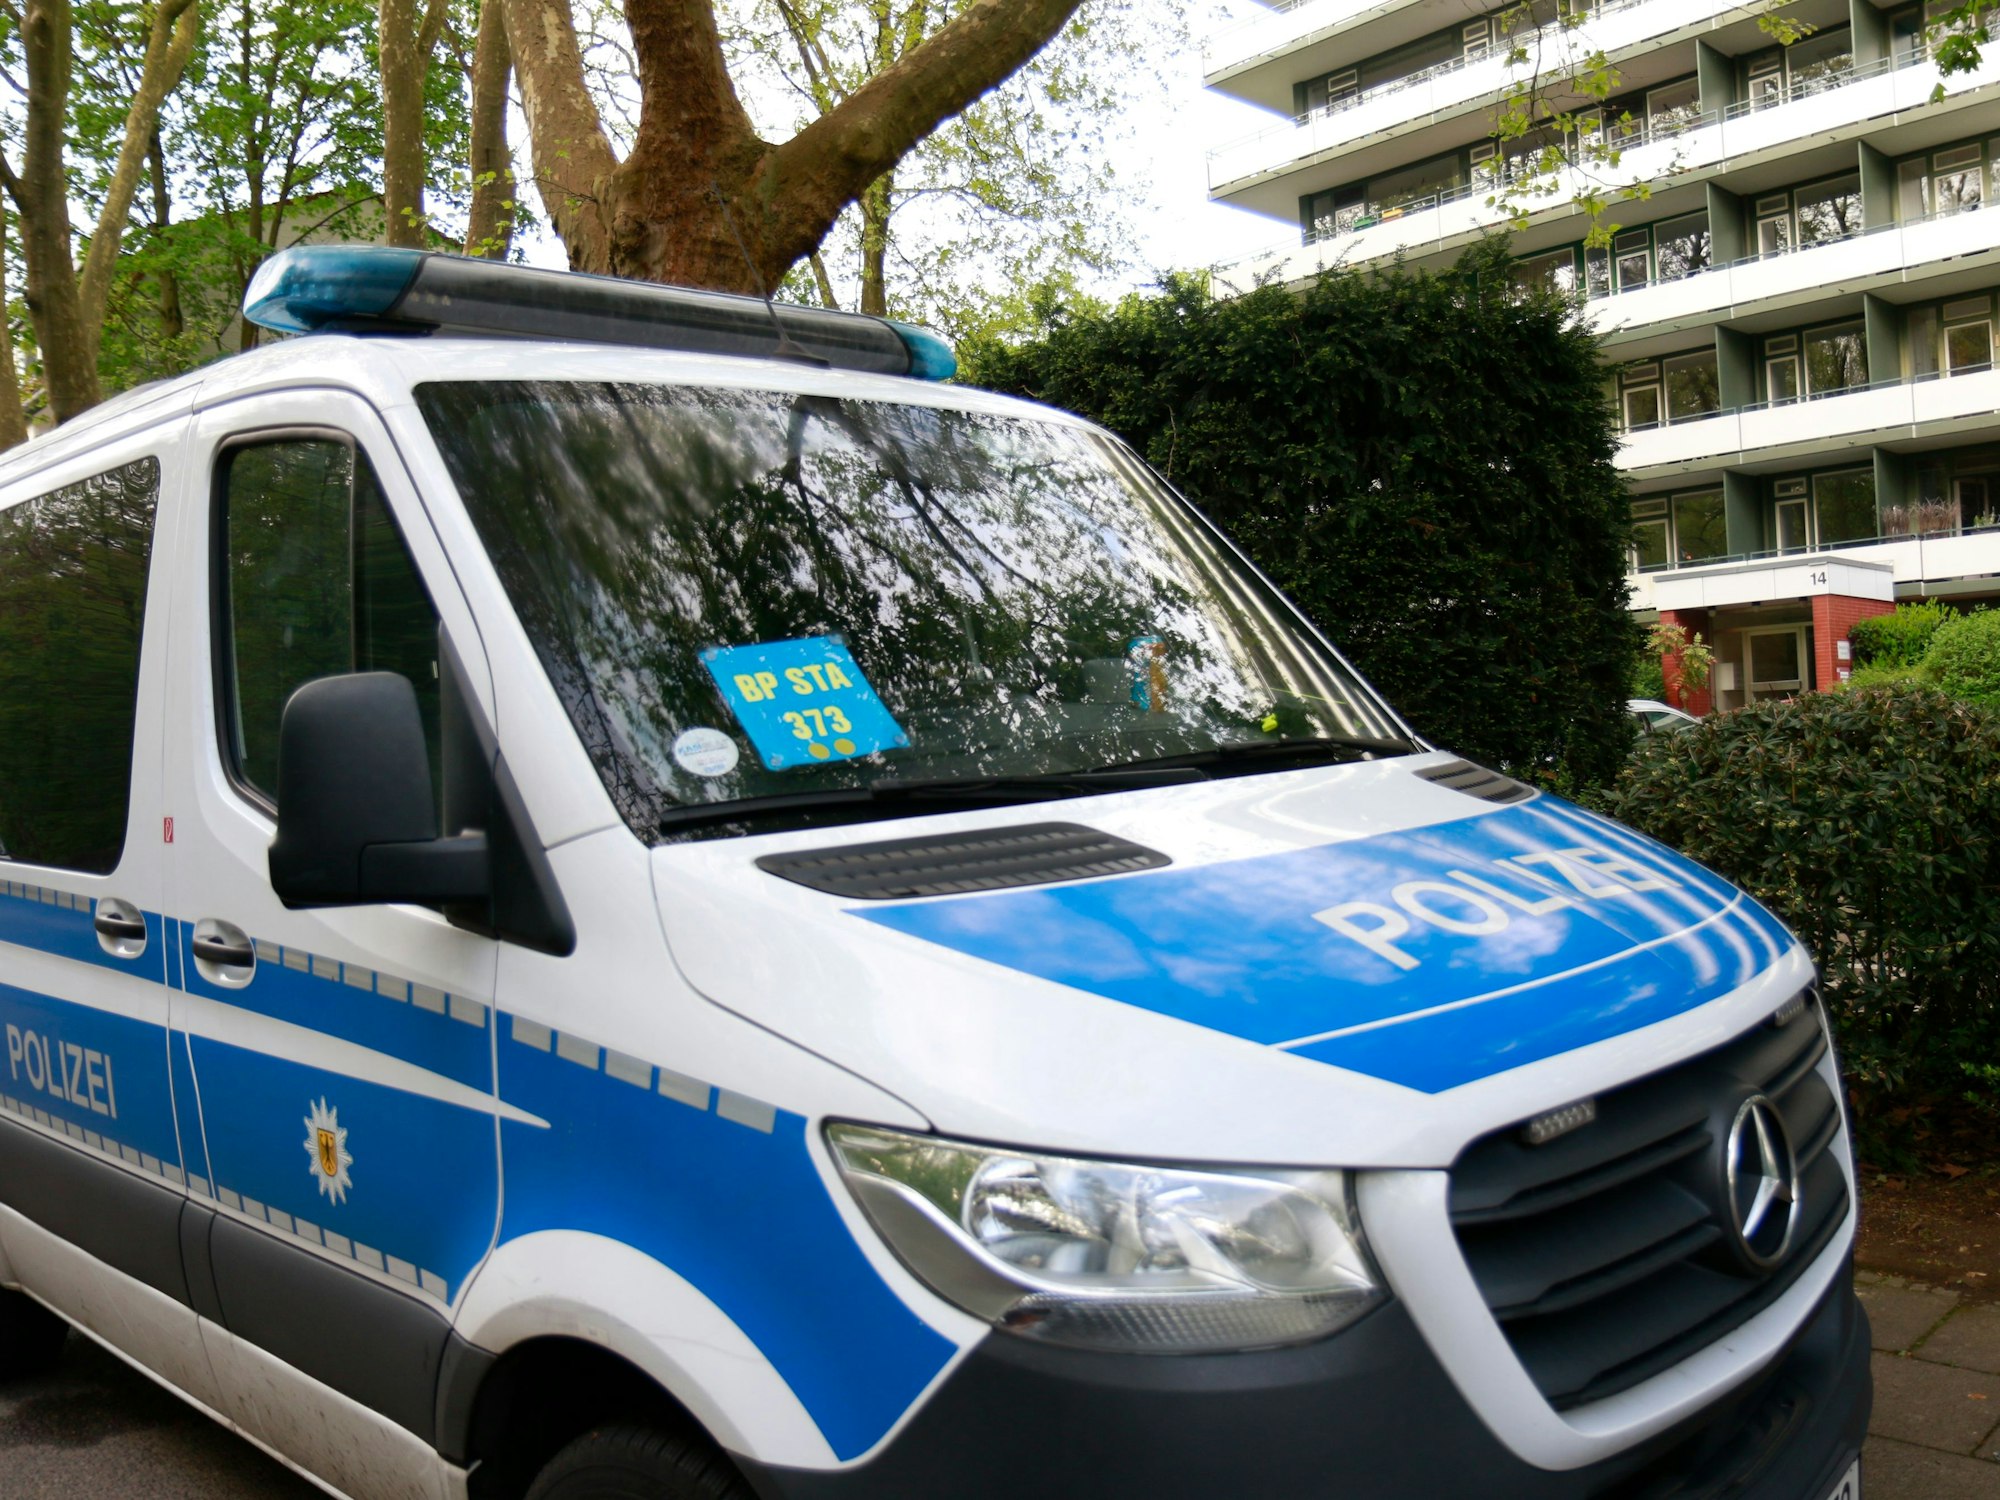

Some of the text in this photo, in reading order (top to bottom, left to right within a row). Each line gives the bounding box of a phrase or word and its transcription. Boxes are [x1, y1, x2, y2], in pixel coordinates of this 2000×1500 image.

[1810, 571, 1827, 586] 14
[733, 662, 853, 703] BP STA
[782, 705, 852, 740] 373
[6, 1022, 118, 1119] POLIZEI
